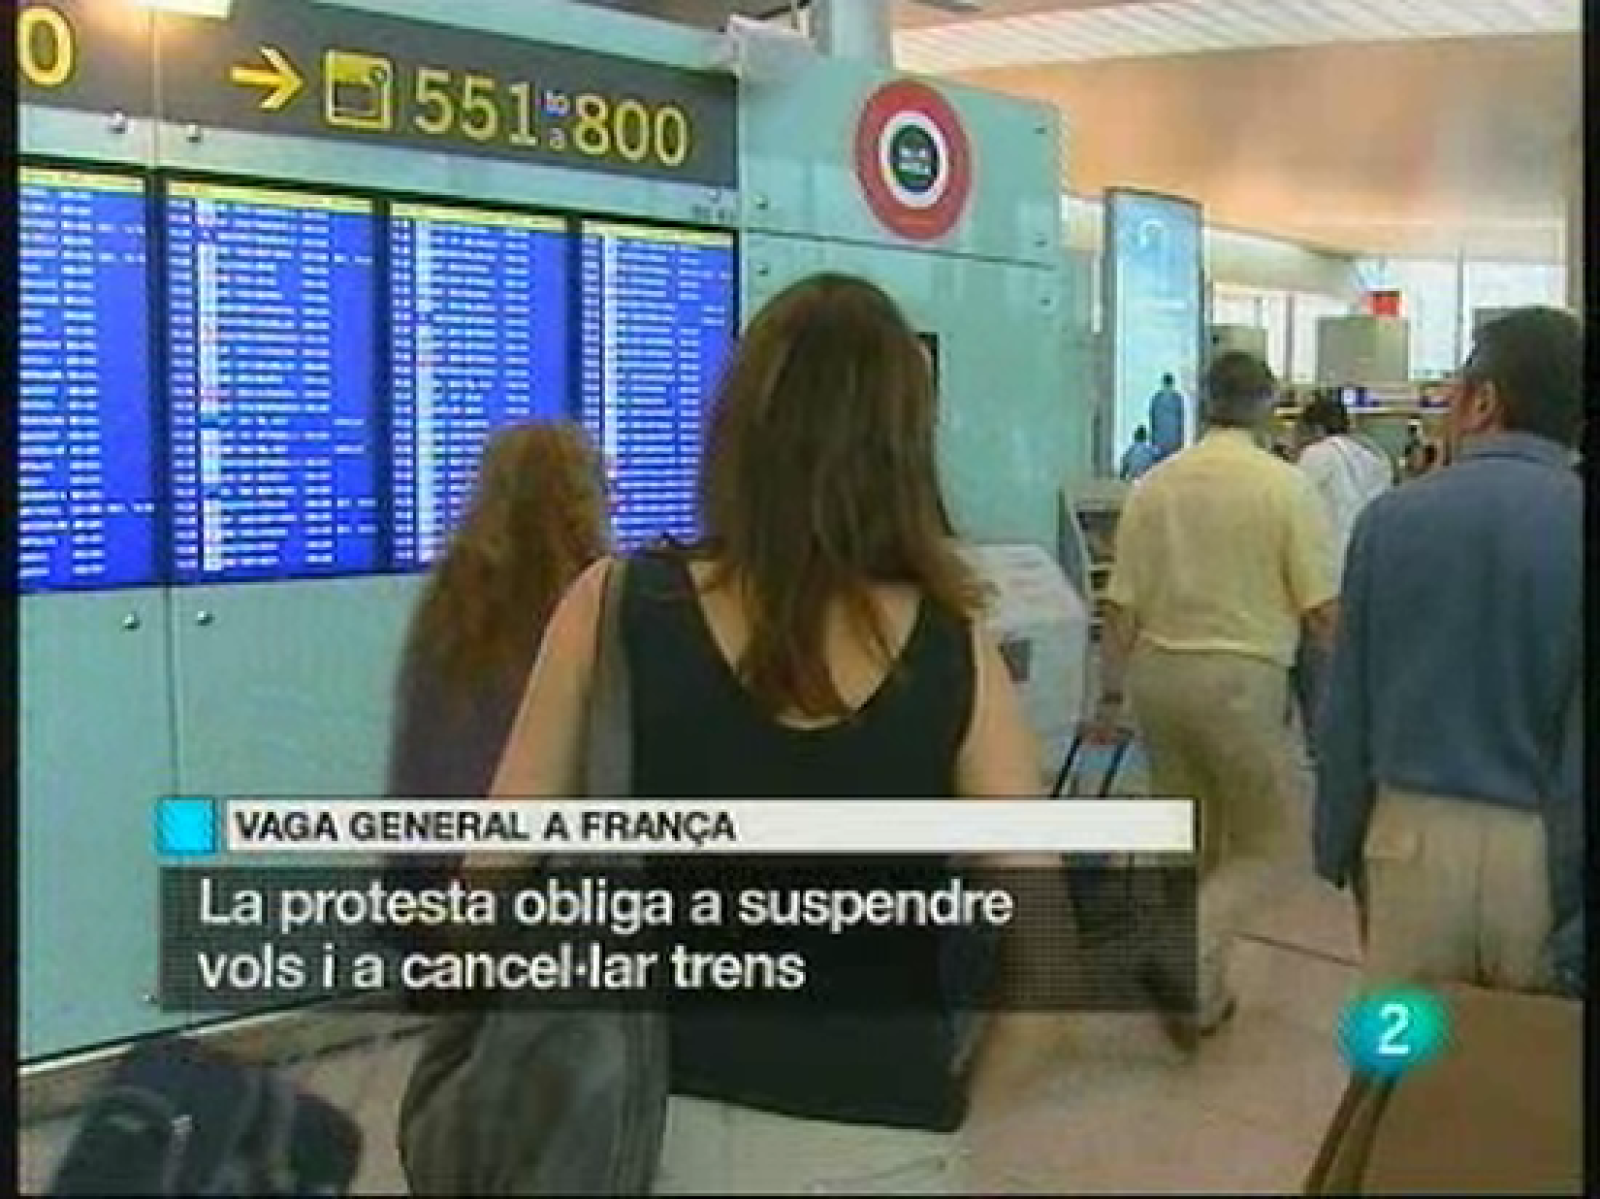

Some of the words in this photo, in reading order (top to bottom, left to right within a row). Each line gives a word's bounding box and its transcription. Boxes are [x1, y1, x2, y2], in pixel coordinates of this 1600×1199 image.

[17, 7, 72, 86] 0
[413, 67, 539, 147] 551
[572, 92, 690, 167] 800
